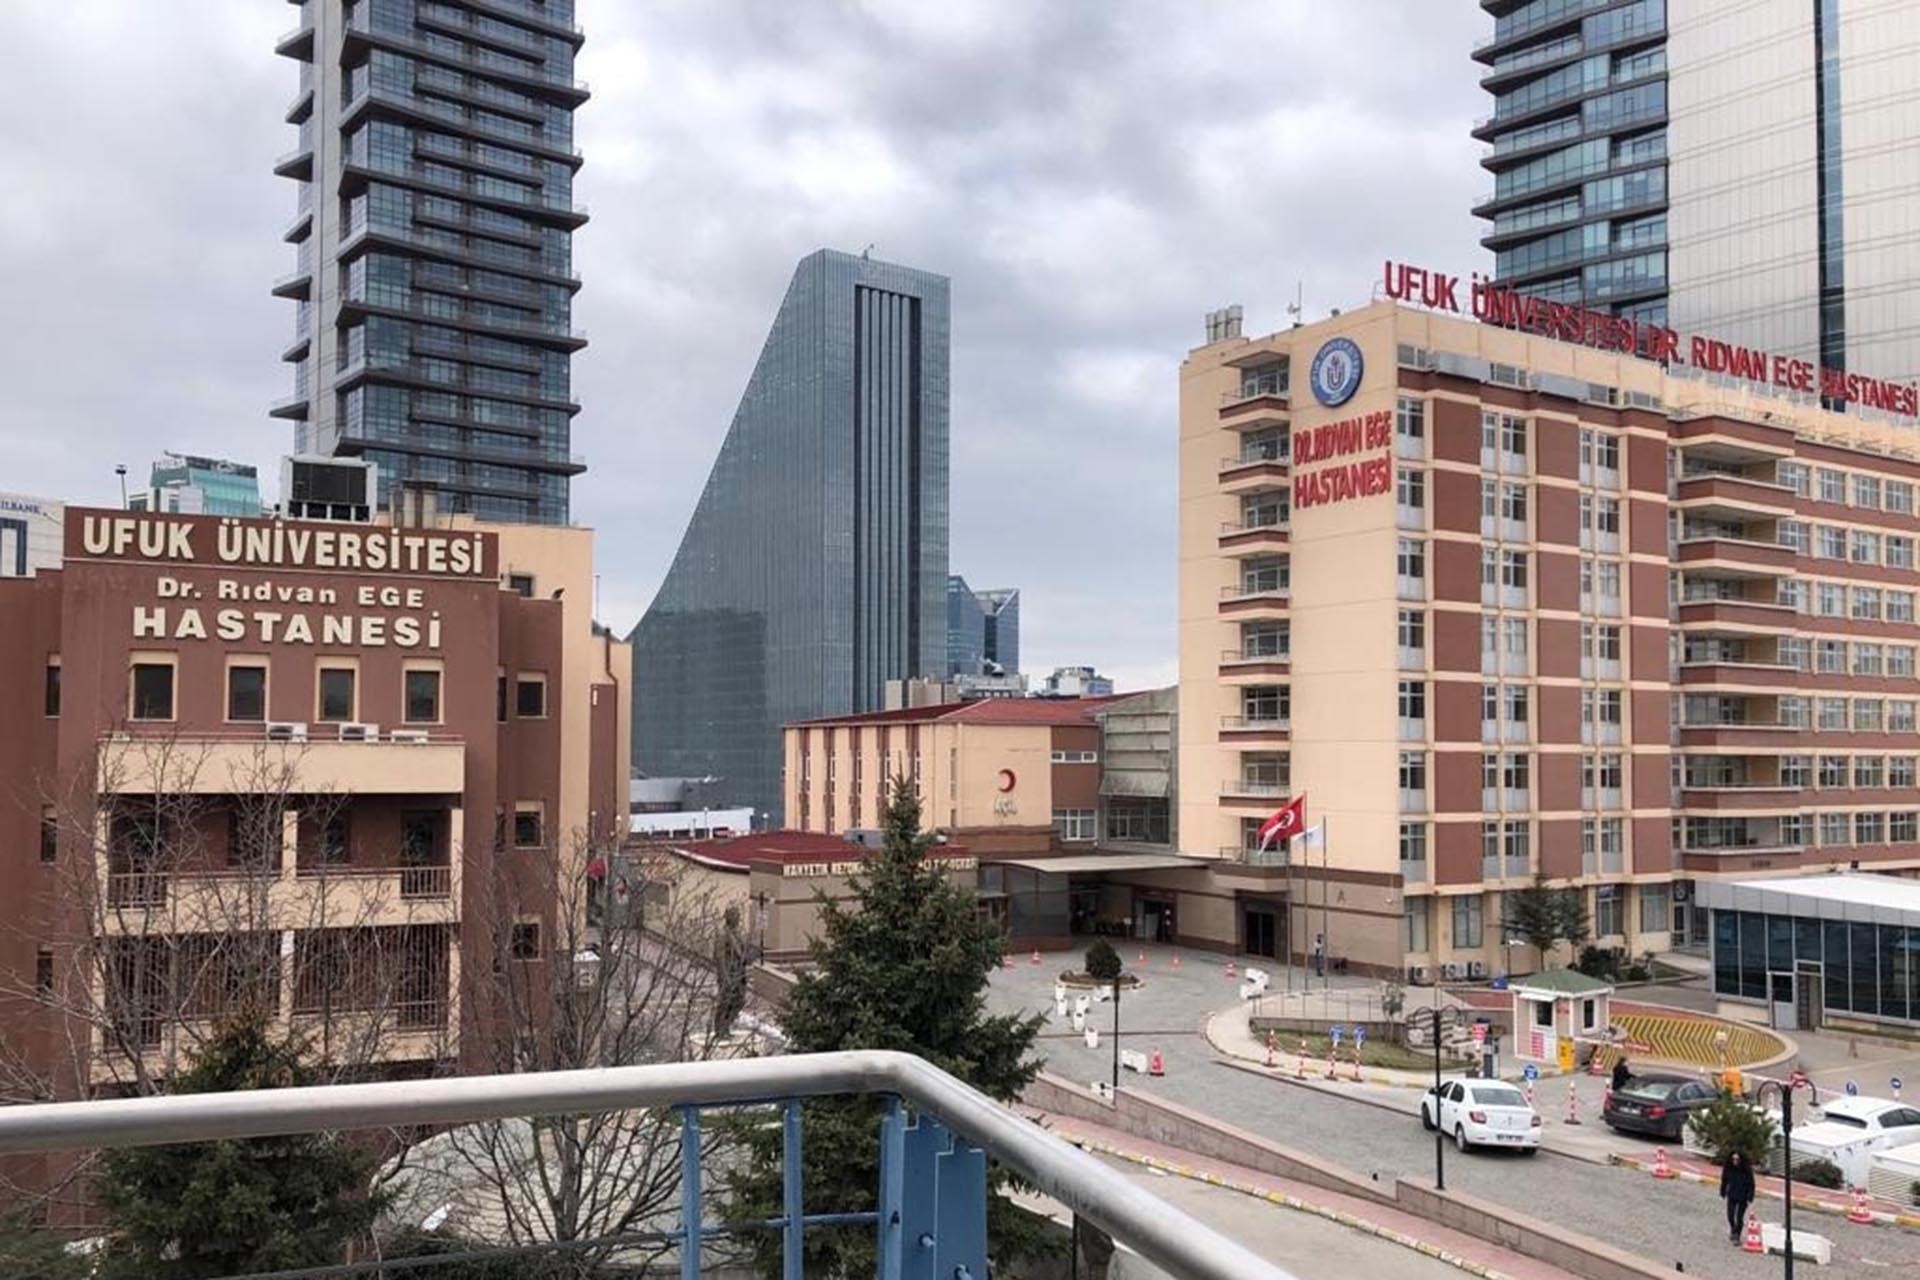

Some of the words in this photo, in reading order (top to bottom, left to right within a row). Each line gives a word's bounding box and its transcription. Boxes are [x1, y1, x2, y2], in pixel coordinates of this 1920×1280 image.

[1384, 260, 1459, 313] UFUK
[1648, 322, 1684, 364] DR.
[1691, 336, 1767, 382] RIDVAN
[1773, 356, 1814, 393] EGE
[1819, 366, 1919, 418] HASTANESİ
[1365, 411, 1392, 450] EGE
[1294, 450, 1392, 508] HASTANESİ
[83, 516, 195, 560] UFUK
[218, 517, 483, 574] ÜNİVERSİTESİ
[157, 576, 201, 598] Dr.
[218, 579, 337, 605] Rıdvan
[358, 586, 424, 608] EGE
[133, 605, 440, 648] HASTANESİ
